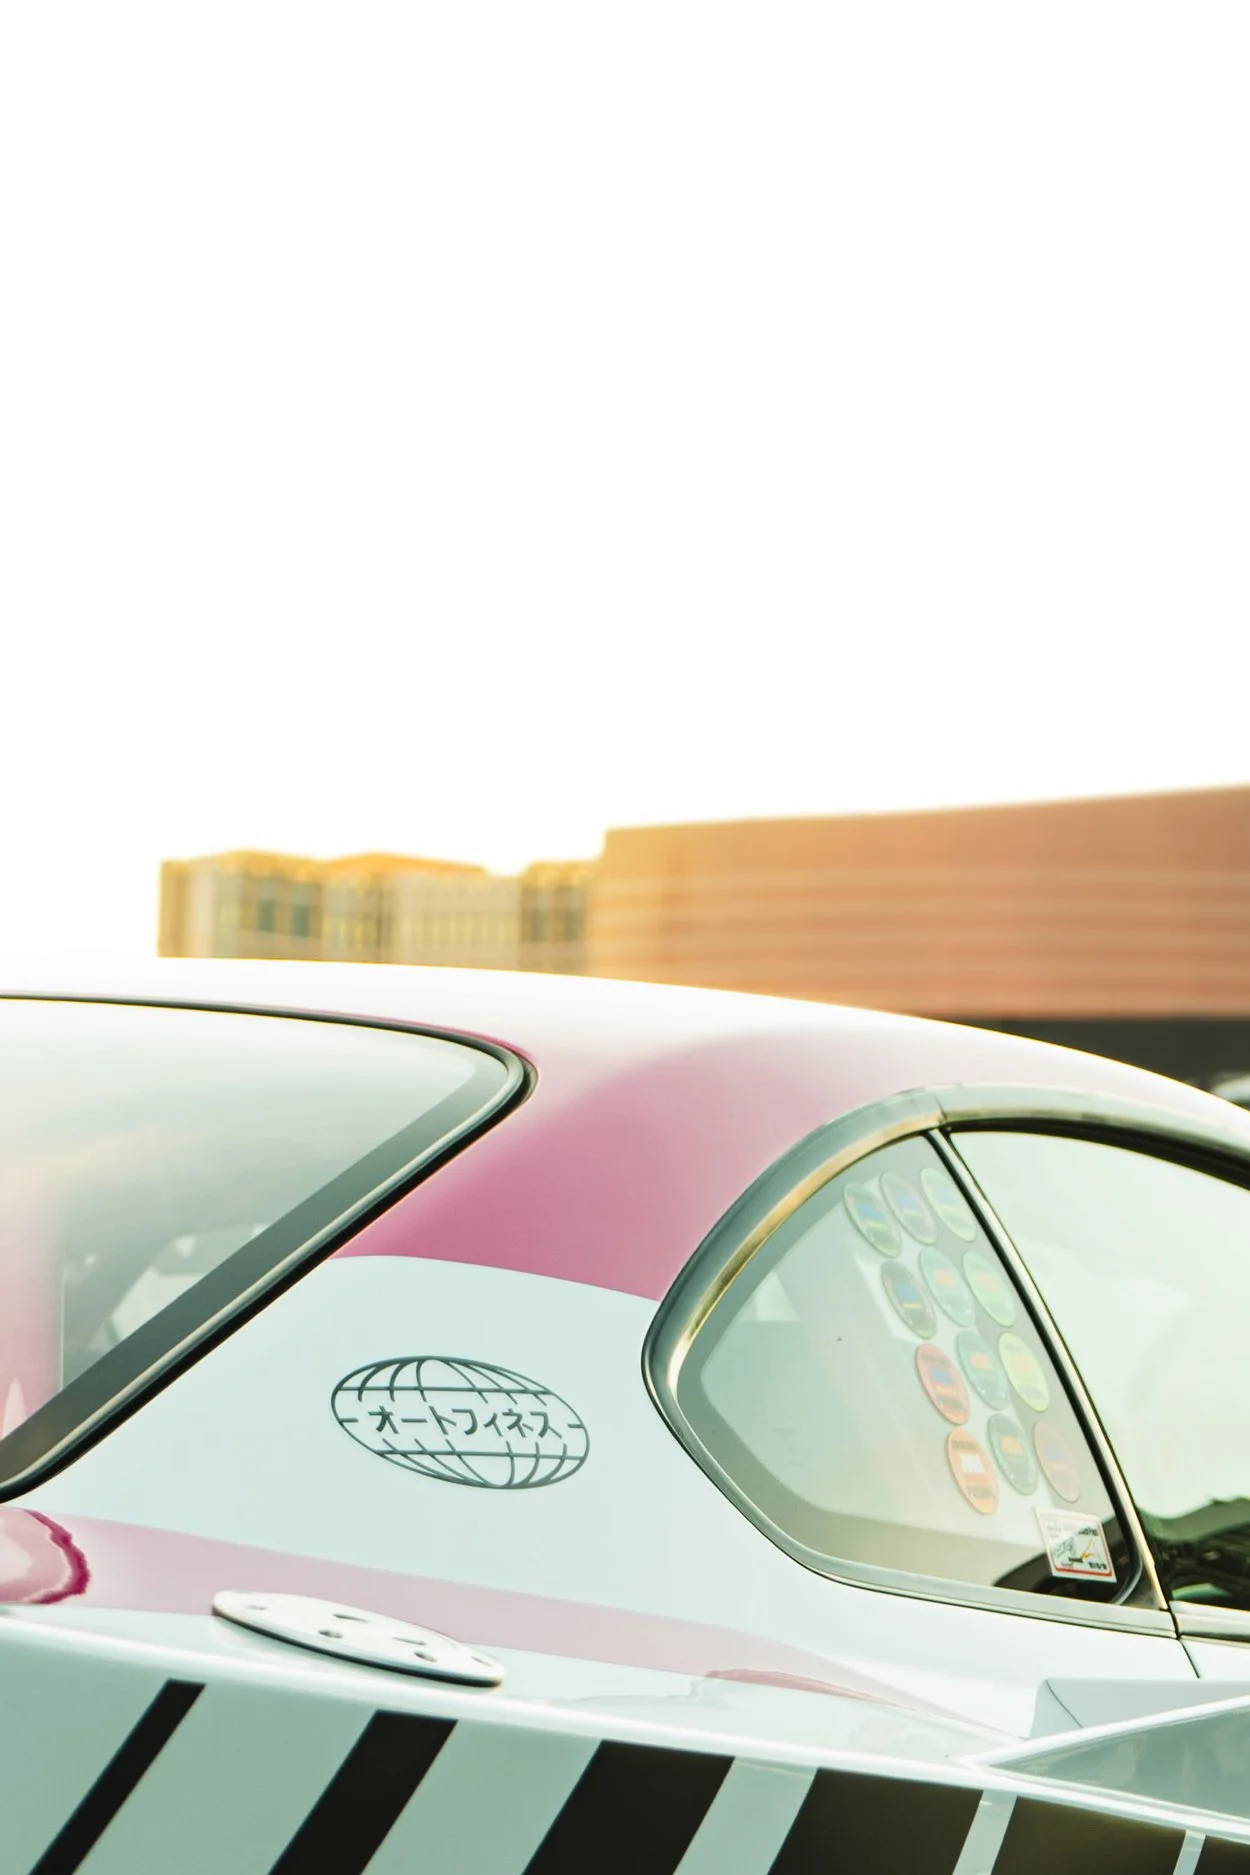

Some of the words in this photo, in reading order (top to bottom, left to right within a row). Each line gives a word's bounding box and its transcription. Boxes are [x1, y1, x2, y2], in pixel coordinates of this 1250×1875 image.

[367, 1405, 563, 1439] オートフィネス
